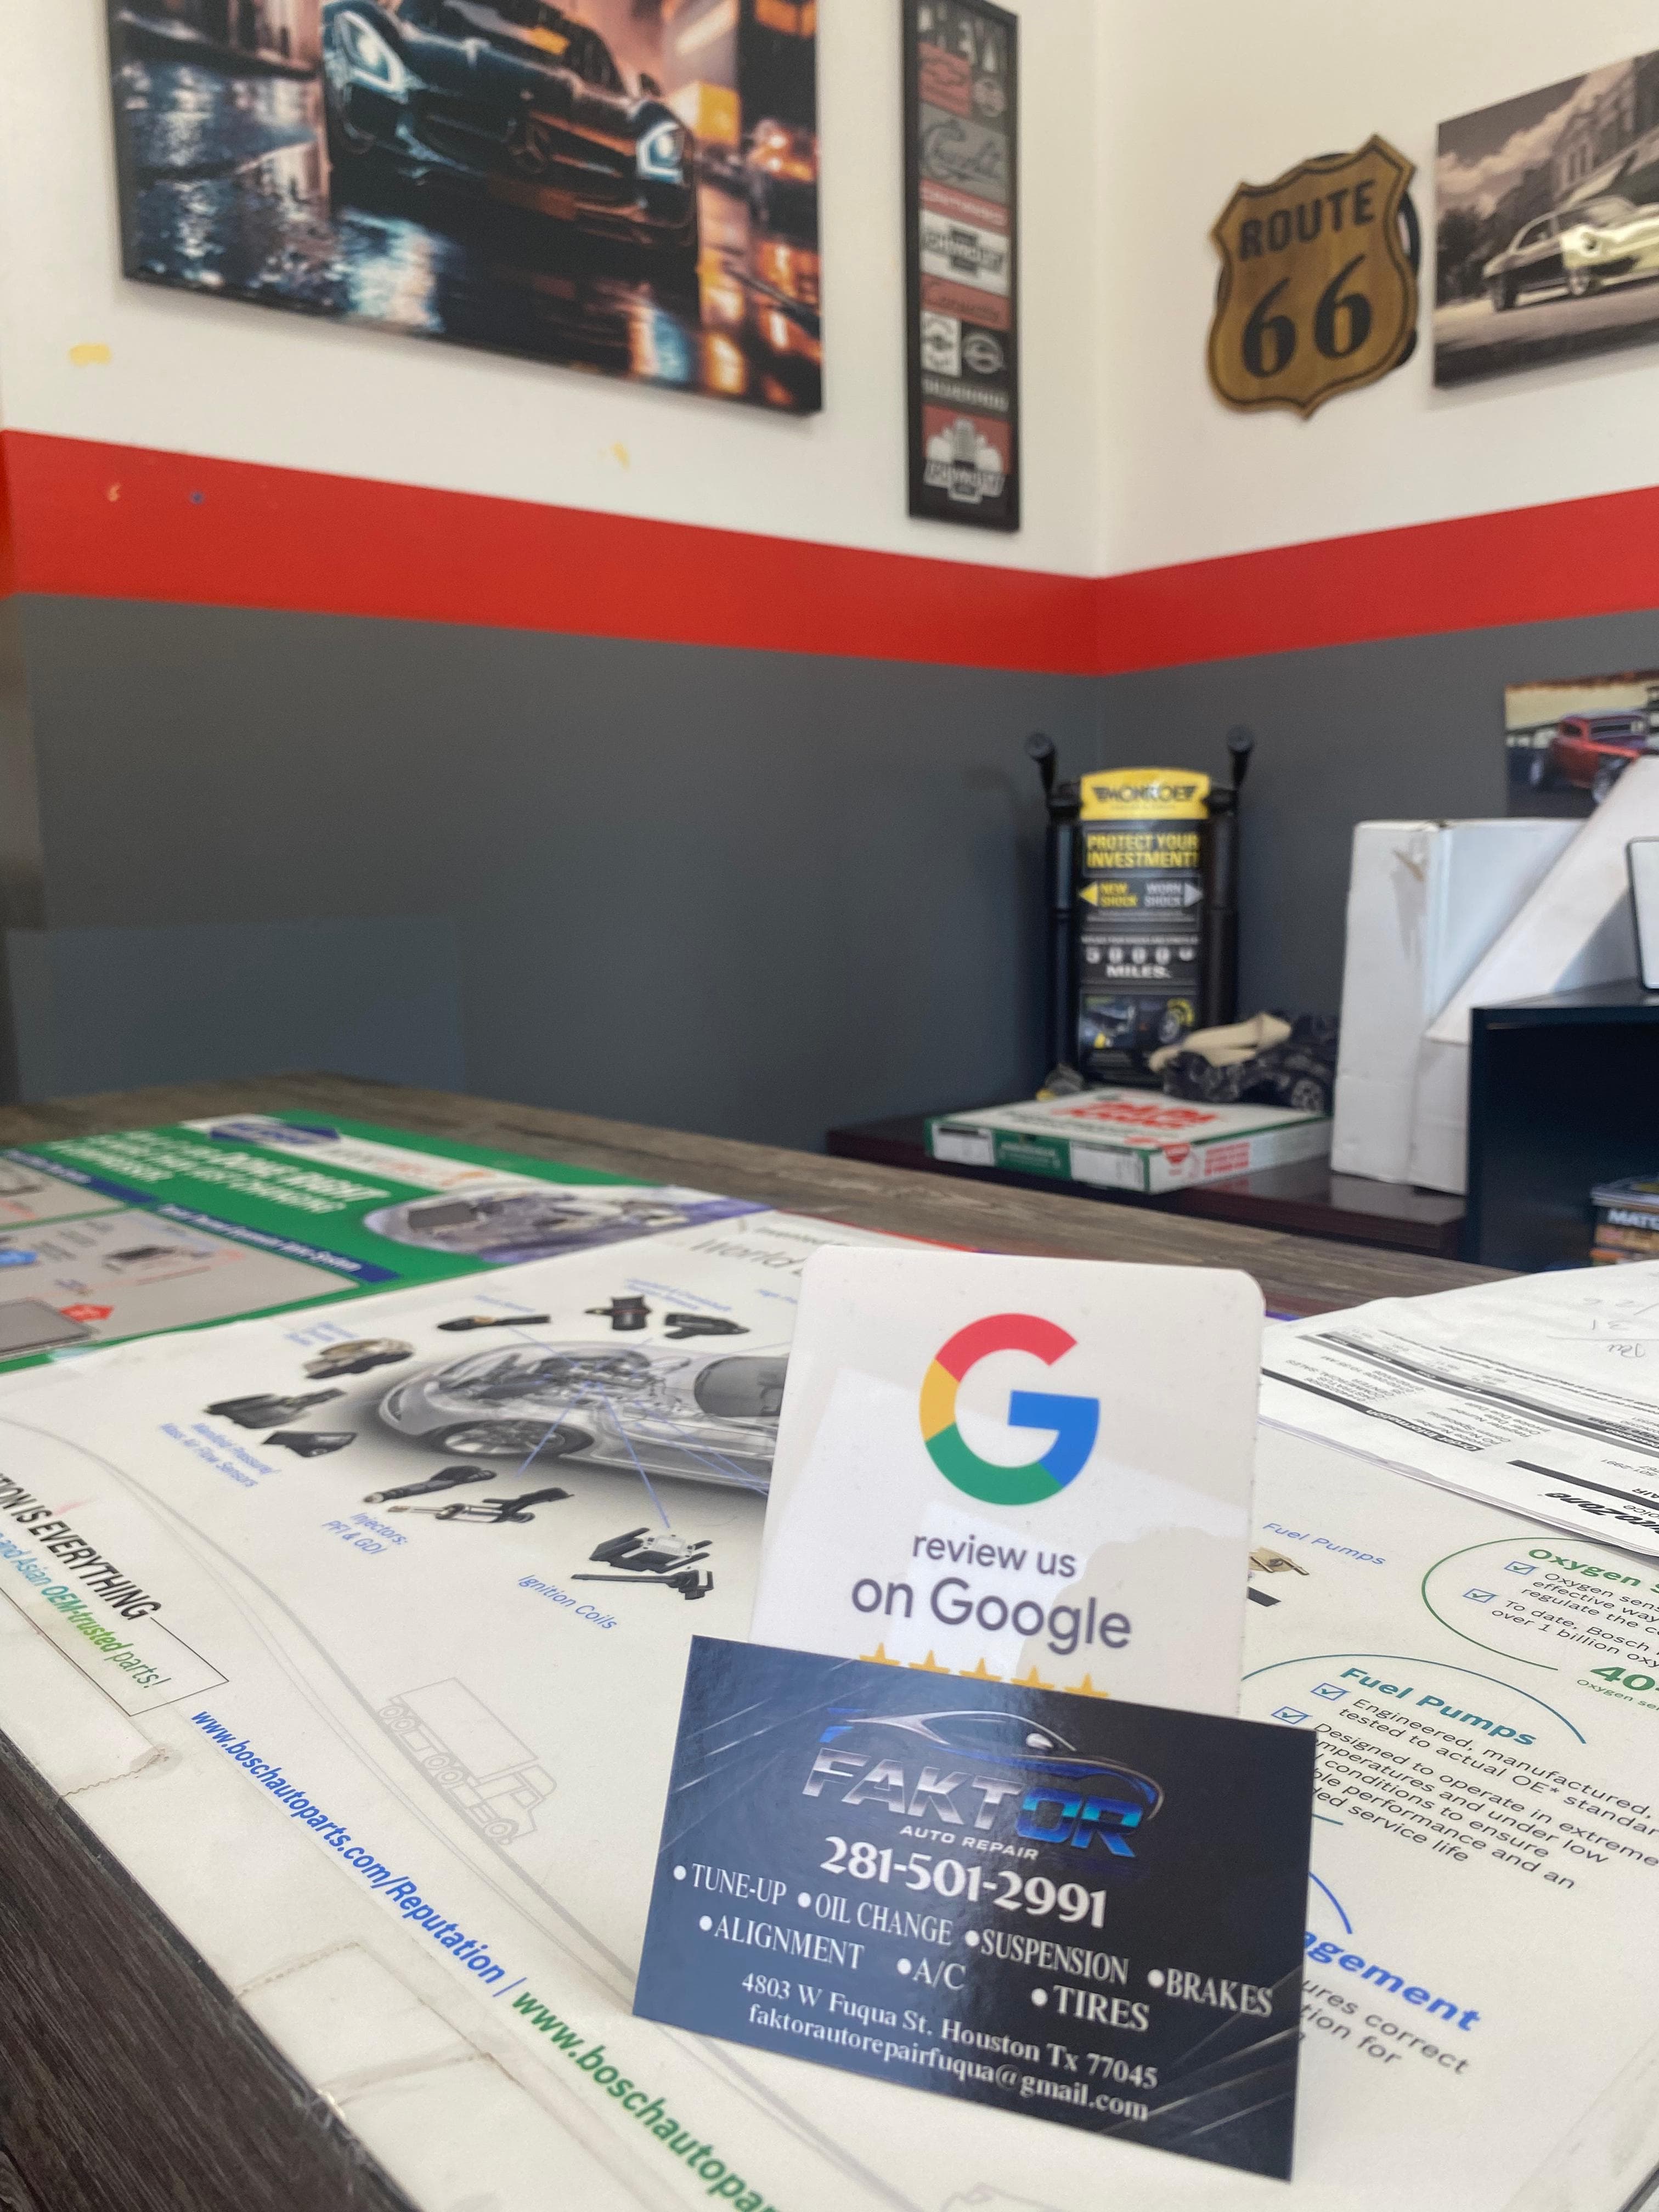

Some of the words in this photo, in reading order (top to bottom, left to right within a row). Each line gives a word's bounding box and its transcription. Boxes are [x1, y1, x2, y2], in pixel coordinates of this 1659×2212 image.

[1239, 178, 1375, 261] ROUTE
[1242, 253, 1373, 379] 66
[1087, 833, 1150, 850] PROTECT
[1154, 833, 1198, 850] YOUR
[1365, 1409, 1435, 1438] Information
[1437, 1436, 1477, 1451] Order
[11, 1504, 53, 1523] IS
[1262, 1522, 1310, 1541] Fuel
[1311, 1537, 1387, 1566] Pumps
[1545, 1492, 1659, 1536] utoZone
[28, 1520, 162, 1621] EVERYTHING
[913, 1534, 1027, 1571] review
[1036, 1549, 1076, 1578] us
[1528, 1548, 1641, 1588] Oxygen
[1545, 1573, 1613, 1598] Oxygen
[517, 1574, 577, 1608] Ignition
[575, 1604, 619, 1630] Coils
[851, 1577, 913, 1618] on
[930, 1576, 1132, 1655] Google
[1504, 1600, 1526, 1612] To
[1531, 1610, 1578, 1630] date,
[1586, 1626, 1650, 1652] Bosch
[1521, 1588, 1600, 1616] regulate
[1606, 1613, 1639, 1628] the
[1532, 1580, 1616, 1609] effective
[41, 1584, 134, 1652] OEM-trusted
[104, 1648, 172, 1689] parts!
[1491, 1610, 1535, 1626] over
[1556, 1627, 1621, 1655] billion
[1340, 1667, 1414, 1699] Fuel
[1415, 1694, 1537, 1746] Pumps
[1576, 1679, 1634, 1702] Oxygen
[1339, 1707, 1406, 1738] tested
[1408, 1735, 1430, 1748] to
[1436, 1747, 1507, 1778] actual
[1352, 1699, 1473, 1752] Engineered,
[1482, 1748, 1651, 1819] manufactured,
[802, 1747, 1143, 1858] FAKTOR
[1314, 1723, 1411, 1765] Designed
[1412, 1762, 1434, 1776] to
[1439, 1774, 1525, 1812] operate
[1530, 1808, 1553, 1825] in
[1559, 1821, 1659, 1866] extreme
[1316, 1740, 1436, 1793] mperatures
[1439, 1791, 1485, 1812] and
[1487, 1810, 1560, 1843] under
[1562, 1839, 1610, 1863] low
[1325, 1759, 1436, 1810] conditions
[1440, 1806, 1464, 1821] to
[1469, 1819, 1550, 1859] ensure
[190, 1710, 506, 1985] www.boschautoparts.com/Reputation
[899, 1825, 955, 1844] AUTO
[961, 1836, 1040, 1861] REPAIR
[1342, 1785, 1487, 1850] performance
[1491, 1847, 1542, 1873] and
[1543, 1870, 1576, 1889] an
[1347, 1805, 1427, 1844] service
[1432, 1835, 1469, 1862] life
[820, 1836, 1107, 1929] 281-501-2991
[691, 1863, 787, 1906] TUNE-UP
[815, 1892, 851, 1925] OIL
[857, 1901, 954, 1946] CHANGE
[980, 1928, 1130, 1985] SUSPENSION
[1165, 1967, 1273, 2018] BRAKES
[715, 1915, 865, 1970] ALIGNMENT
[912, 1957, 967, 1990] A/C
[1053, 1984, 1150, 2032] TIRES
[742, 1972, 791, 2000] 4803
[798, 1984, 822, 2007] W
[828, 1991, 898, 2028] Fuqua
[902, 2008, 934, 2036] St.
[940, 2017, 1041, 2062] Houston
[1046, 2042, 1079, 2073] Tx
[1086, 2052, 1158, 2090] 77045
[749, 2004, 1149, 2122] faktorautorepairfuqua@gmail.com
[1356, 2035, 1403, 2064] for
[1364, 2013, 1470, 2075] correct
